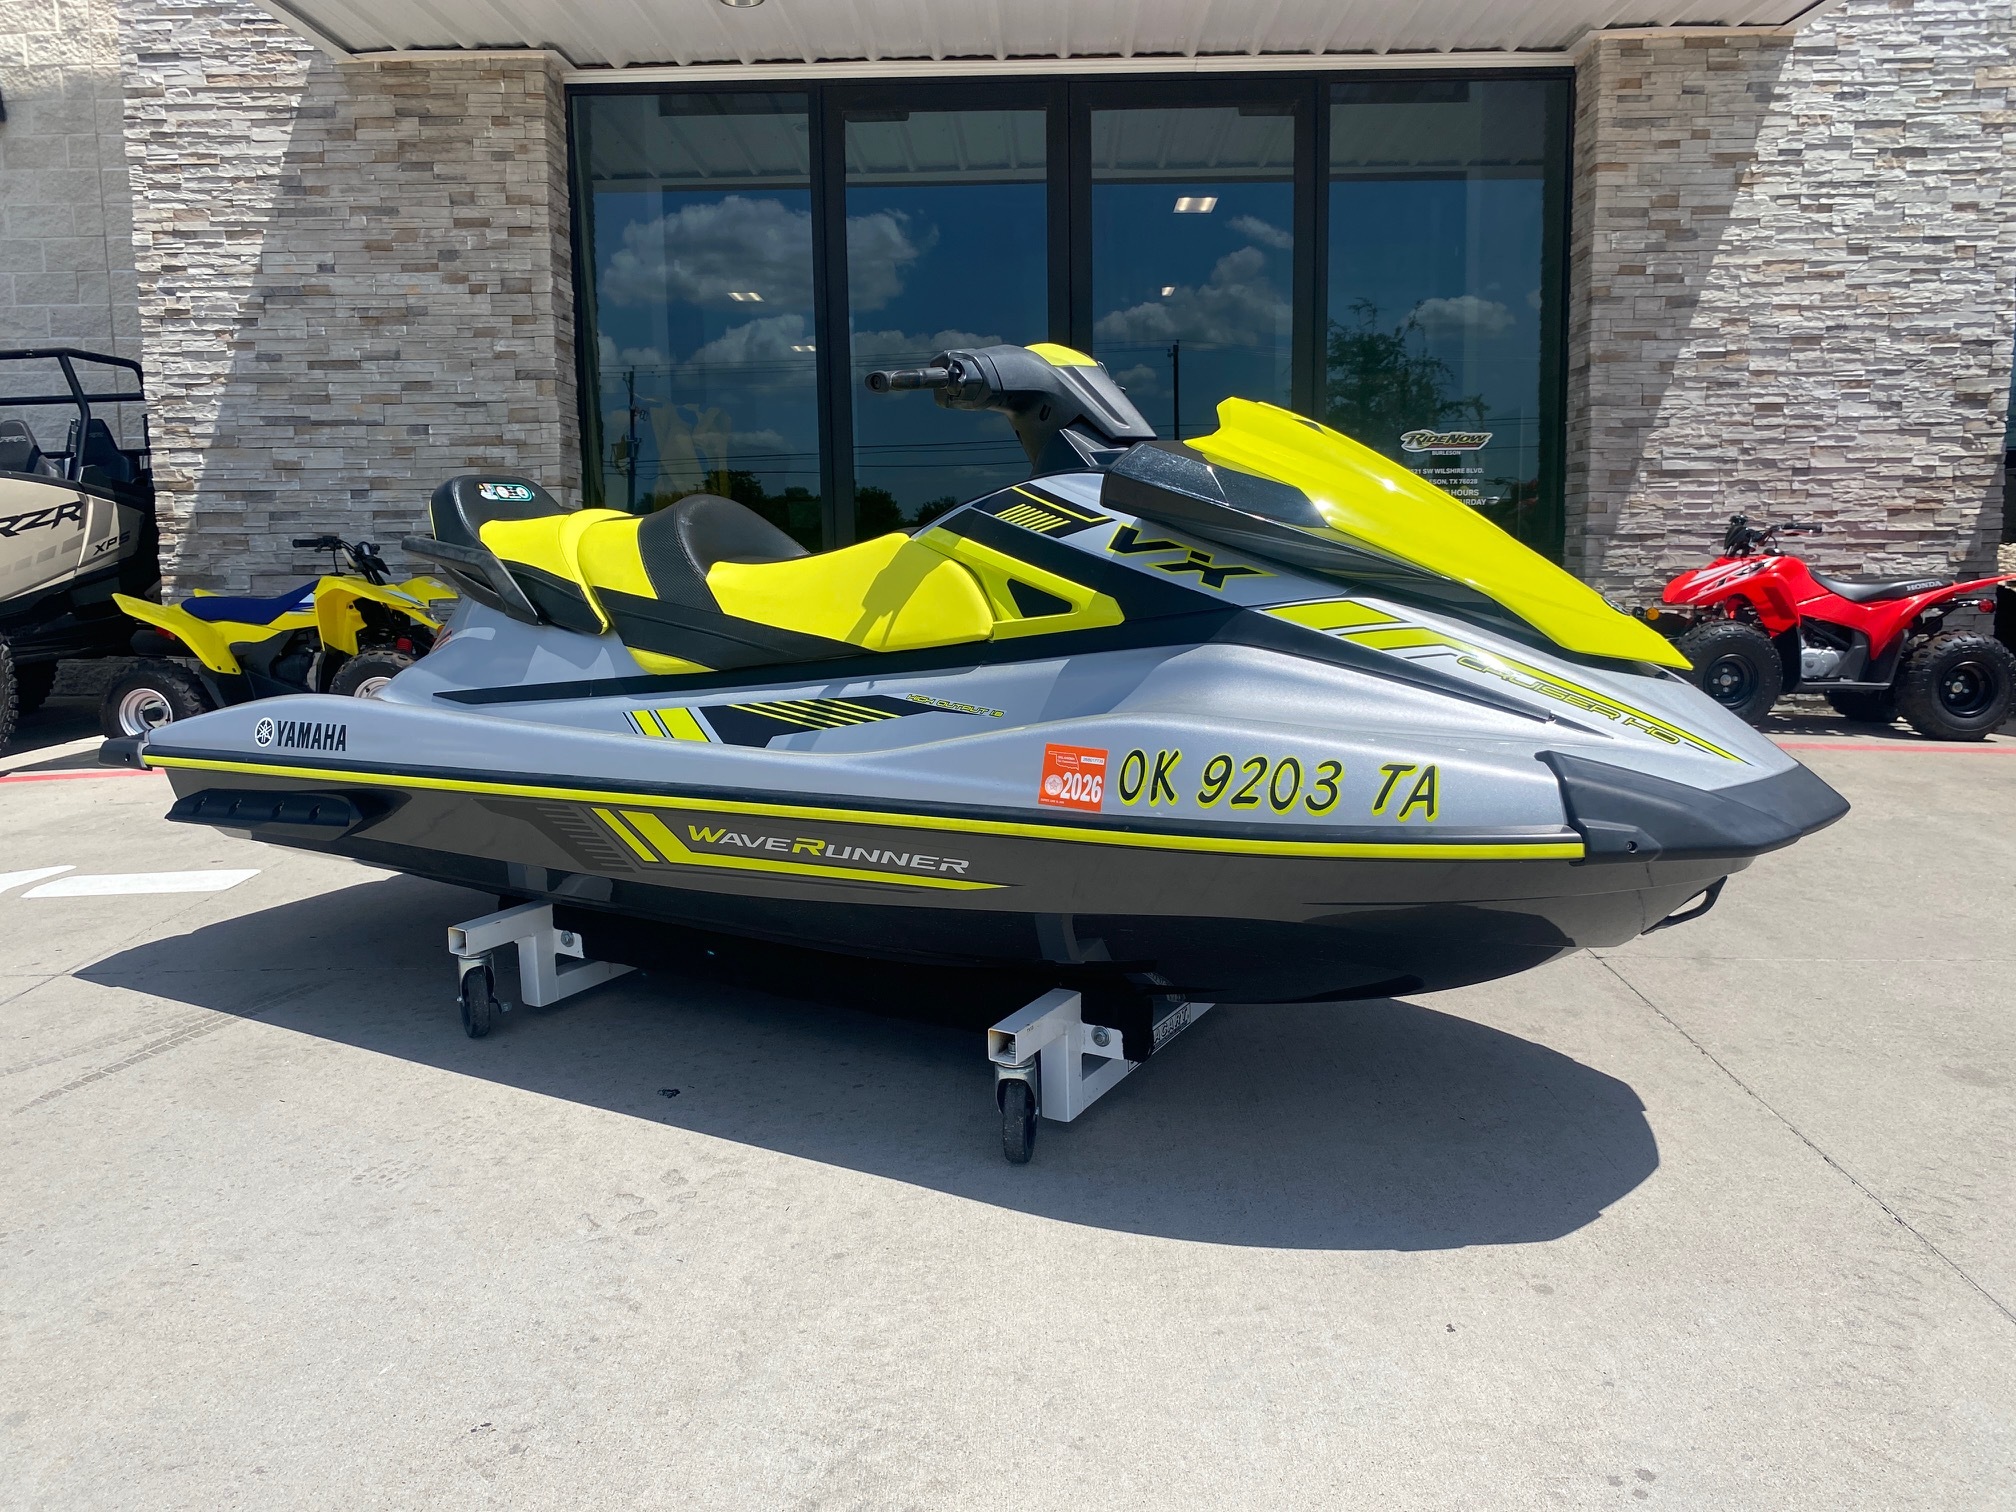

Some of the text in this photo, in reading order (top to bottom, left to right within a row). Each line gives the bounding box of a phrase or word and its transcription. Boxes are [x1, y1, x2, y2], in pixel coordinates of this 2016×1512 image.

[1105, 522, 1279, 592] VX
[1906, 580, 1943, 591] HONDA
[1456, 655, 1680, 745] CRUISER HO
[276, 720, 347, 751] YAMAHA
[1060, 771, 1103, 804] 2026
[1117, 748, 1440, 824] OK 9203 TA
